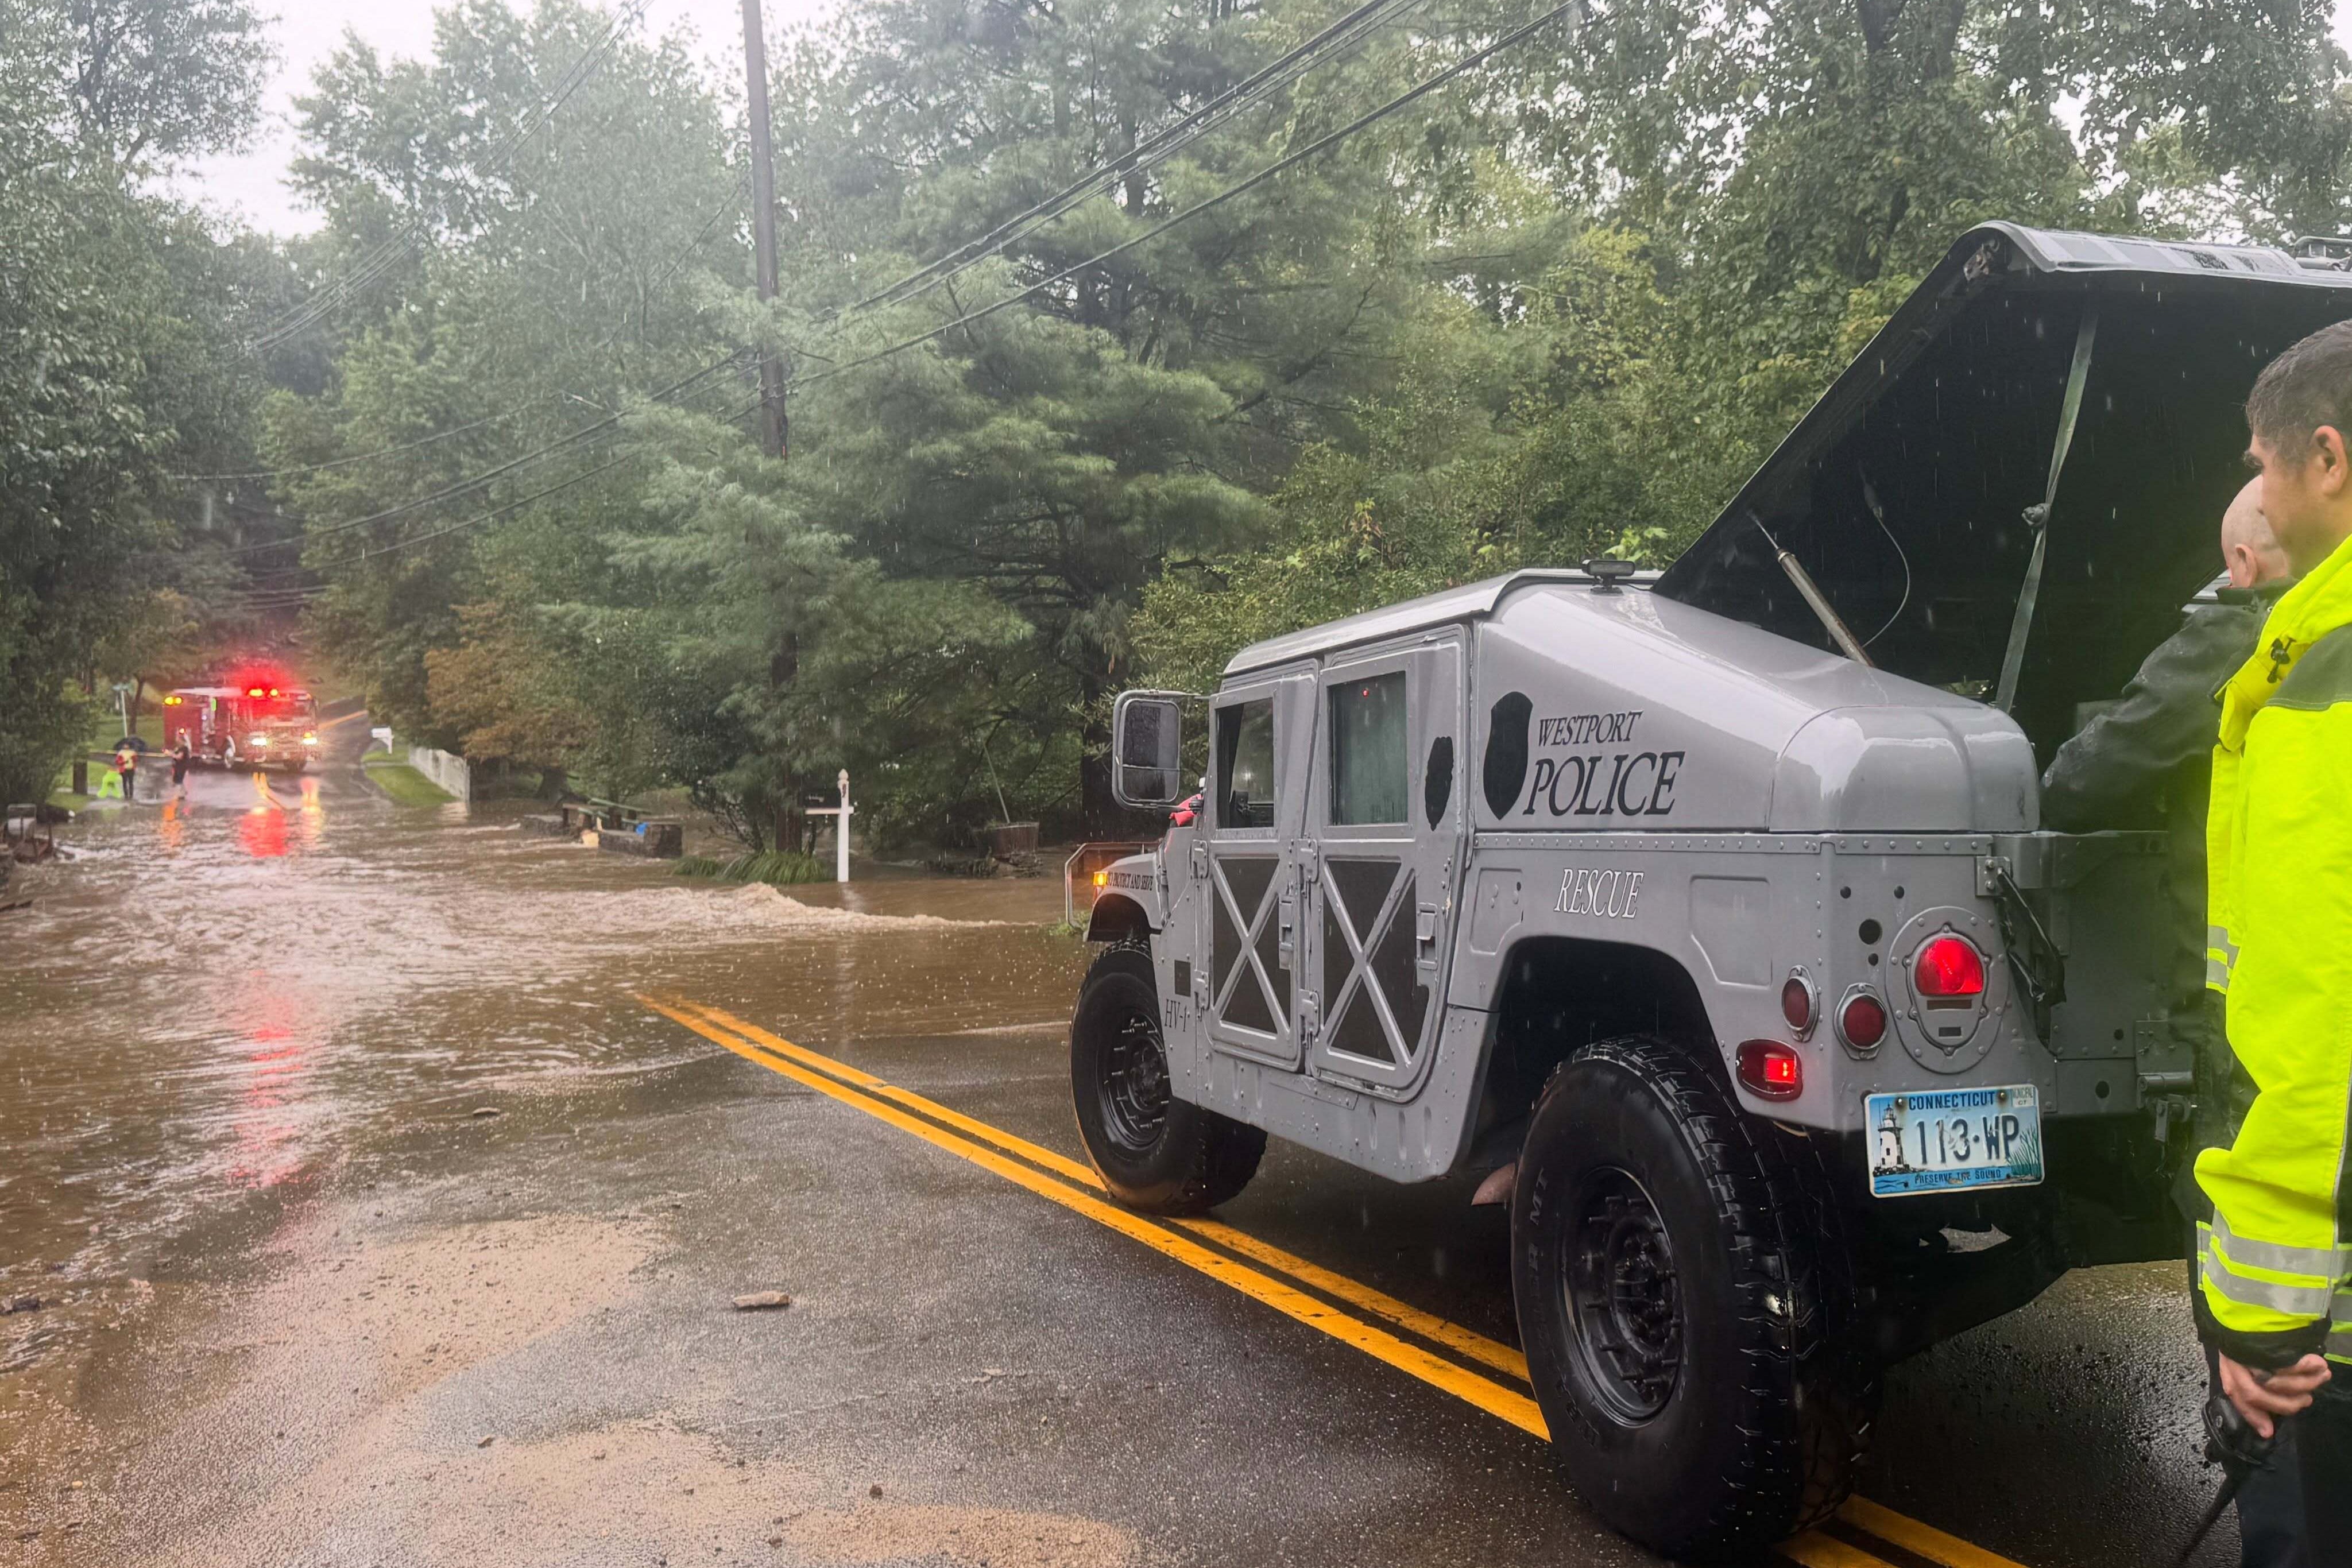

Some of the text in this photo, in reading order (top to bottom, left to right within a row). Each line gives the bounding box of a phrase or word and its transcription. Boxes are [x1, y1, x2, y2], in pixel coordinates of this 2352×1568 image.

[1539, 710, 1643, 746] WESTPORT
[1522, 751, 1686, 816] POLICE
[1130, 874, 1140, 889] AND
[1141, 875, 1153, 891] SERVE
[1553, 868, 1644, 919] RESCUE
[1165, 999, 1187, 1032] HV-1
[1909, 1091, 1995, 1110] CONNECTICUT
[1914, 1170, 2001, 1184] PRESERVE THE SOUND
